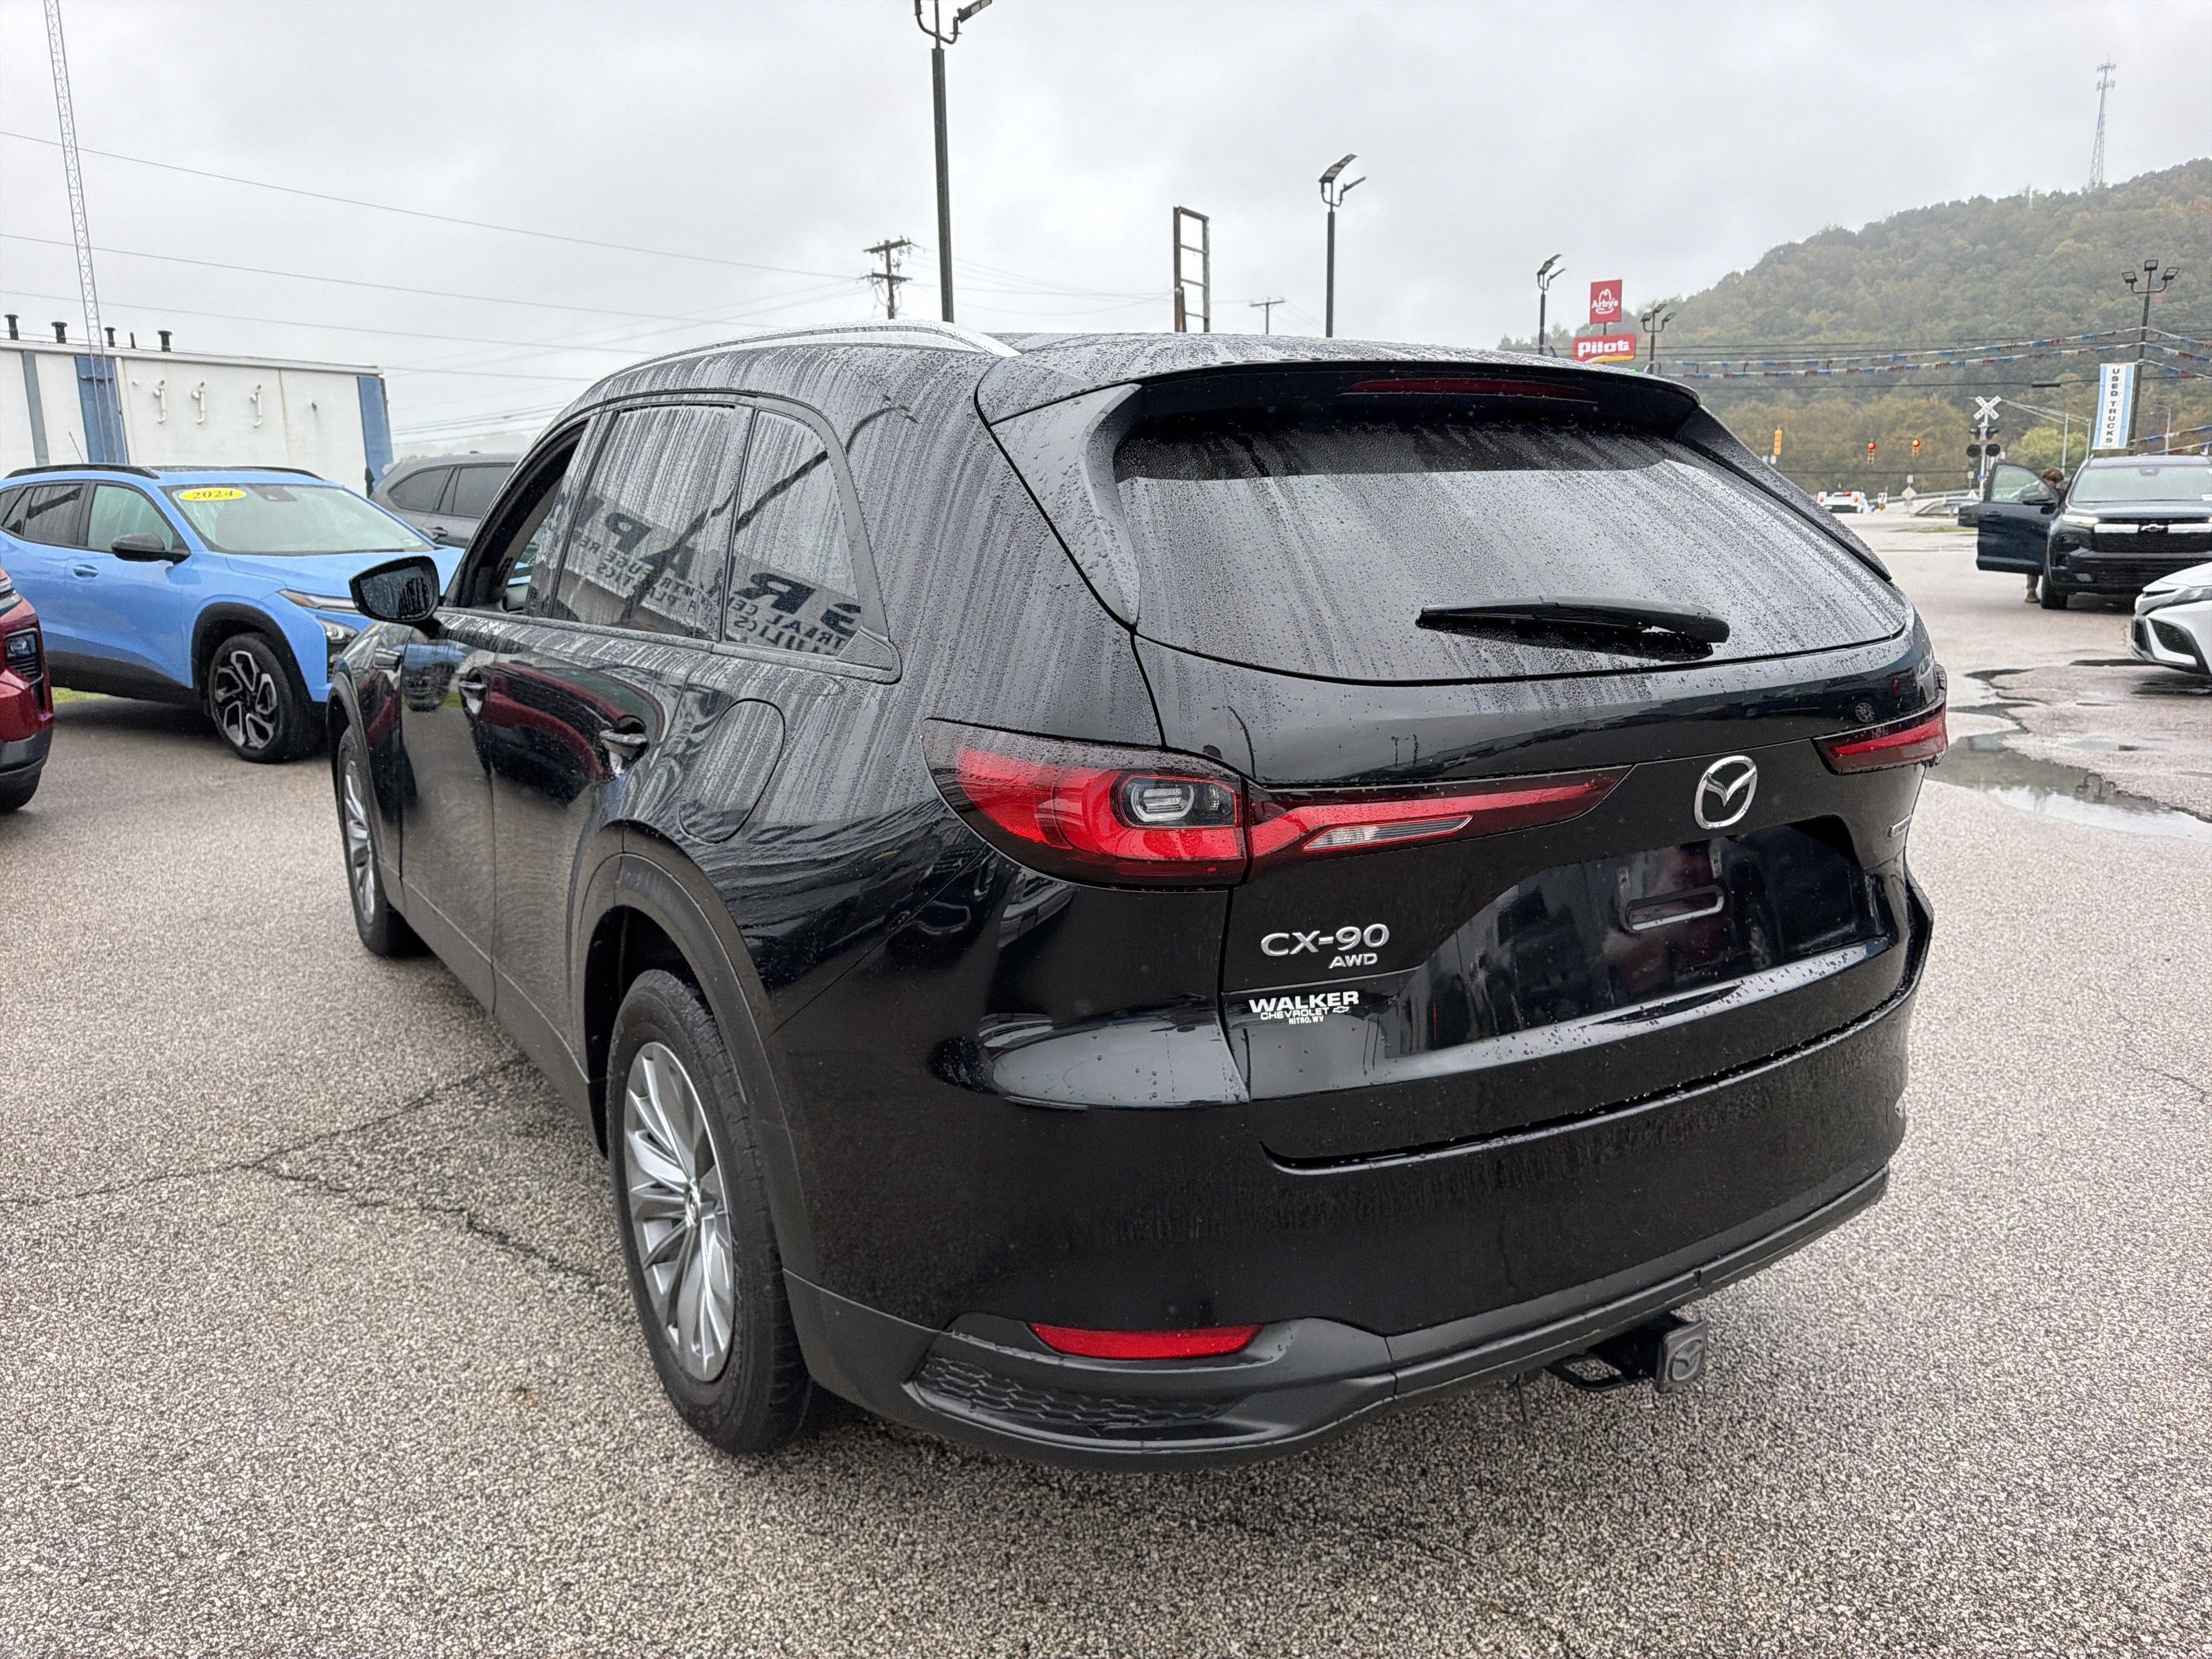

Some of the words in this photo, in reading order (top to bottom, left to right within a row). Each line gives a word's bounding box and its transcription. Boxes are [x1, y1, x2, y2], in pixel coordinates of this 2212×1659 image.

[1578, 340, 1630, 358] Pilot
[2110, 368, 2120, 397] USED
[2106, 400, 2117, 443] TRUCKS
[193, 490, 233, 500] 2024
[1261, 923, 1390, 957] CX-90
[1328, 953, 1378, 969] AWD
[1249, 991, 1359, 1013] WALKER
[1260, 1007, 1330, 1020] CHEVROLET
